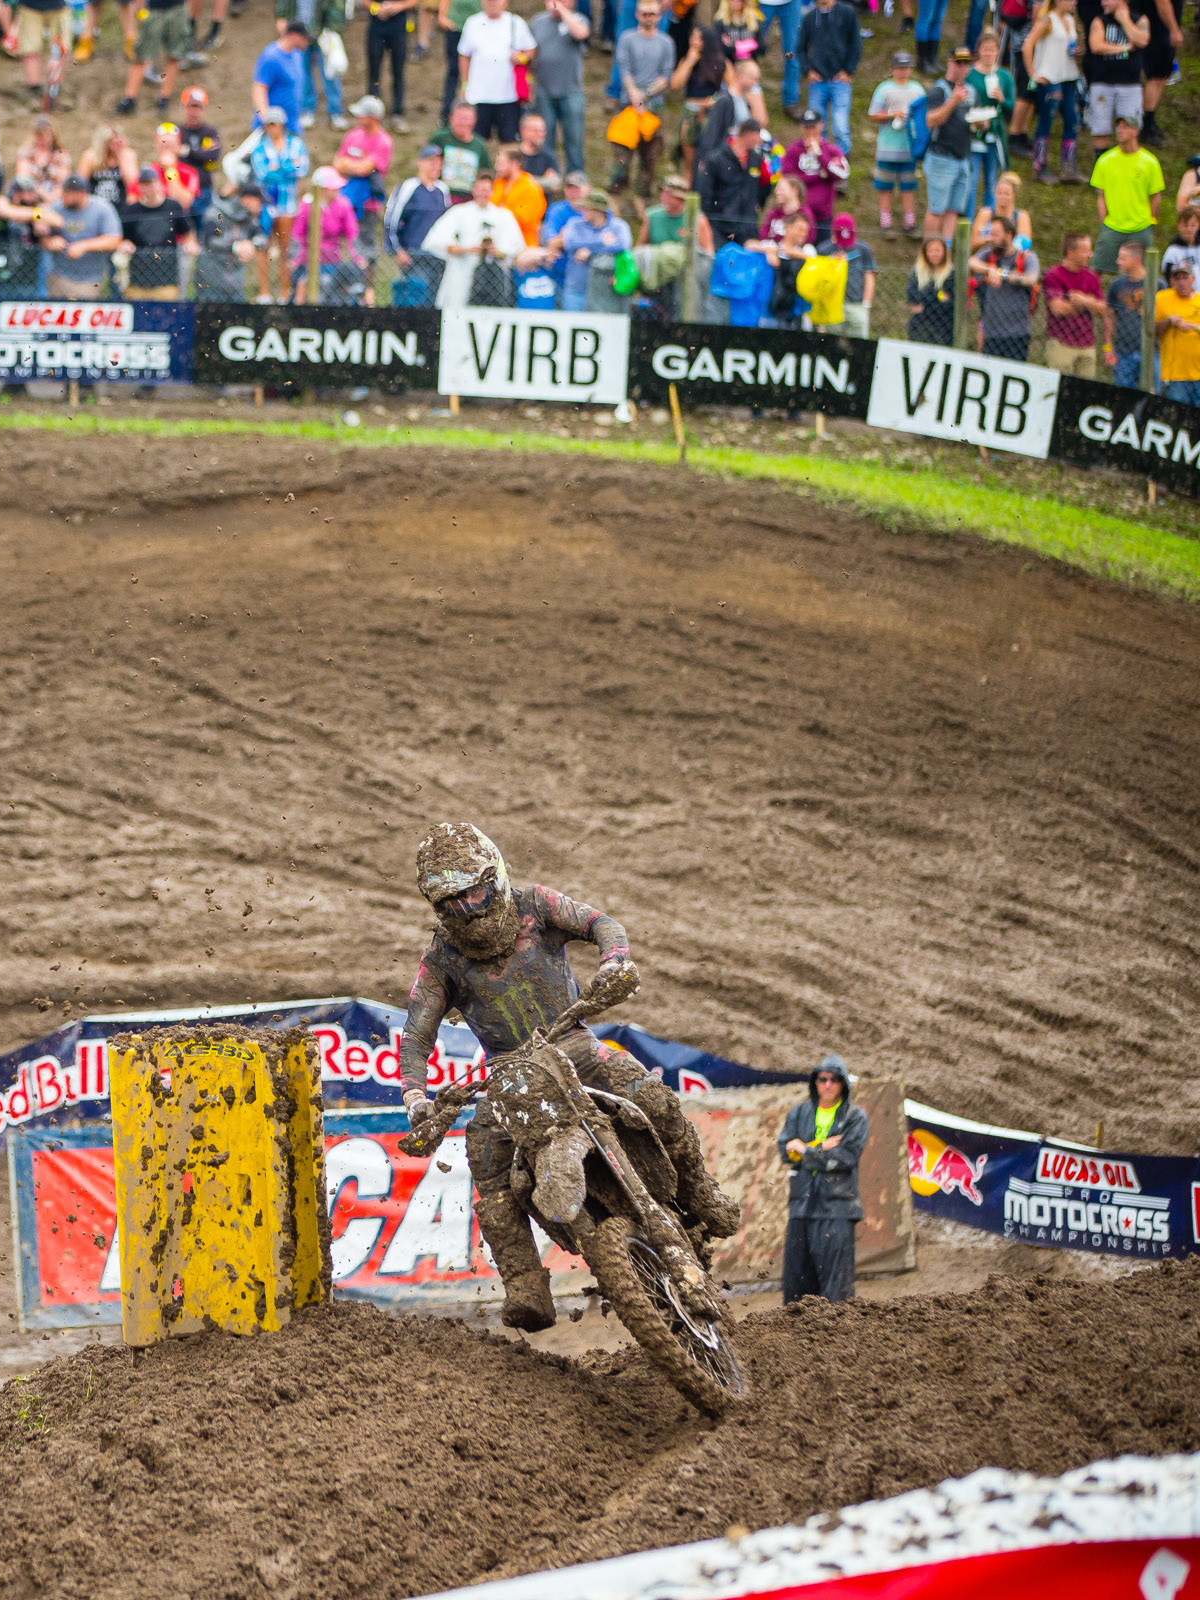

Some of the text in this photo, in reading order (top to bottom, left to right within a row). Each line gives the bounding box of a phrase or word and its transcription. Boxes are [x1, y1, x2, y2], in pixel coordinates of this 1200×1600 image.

[7, 308, 124, 329] LUCAS OIL
[466, 320, 601, 388] VIRB
[901, 355, 1031, 438] VIRB
[35, 1044, 105, 1110] Bull
[1040, 1152, 1134, 1188] LUCAS OIL
[1003, 1190, 1170, 1243] MOTOCROSS
[1064, 1186, 1112, 1205] PRO
[1003, 1219, 1172, 1256] CHAMPIONSHIP
